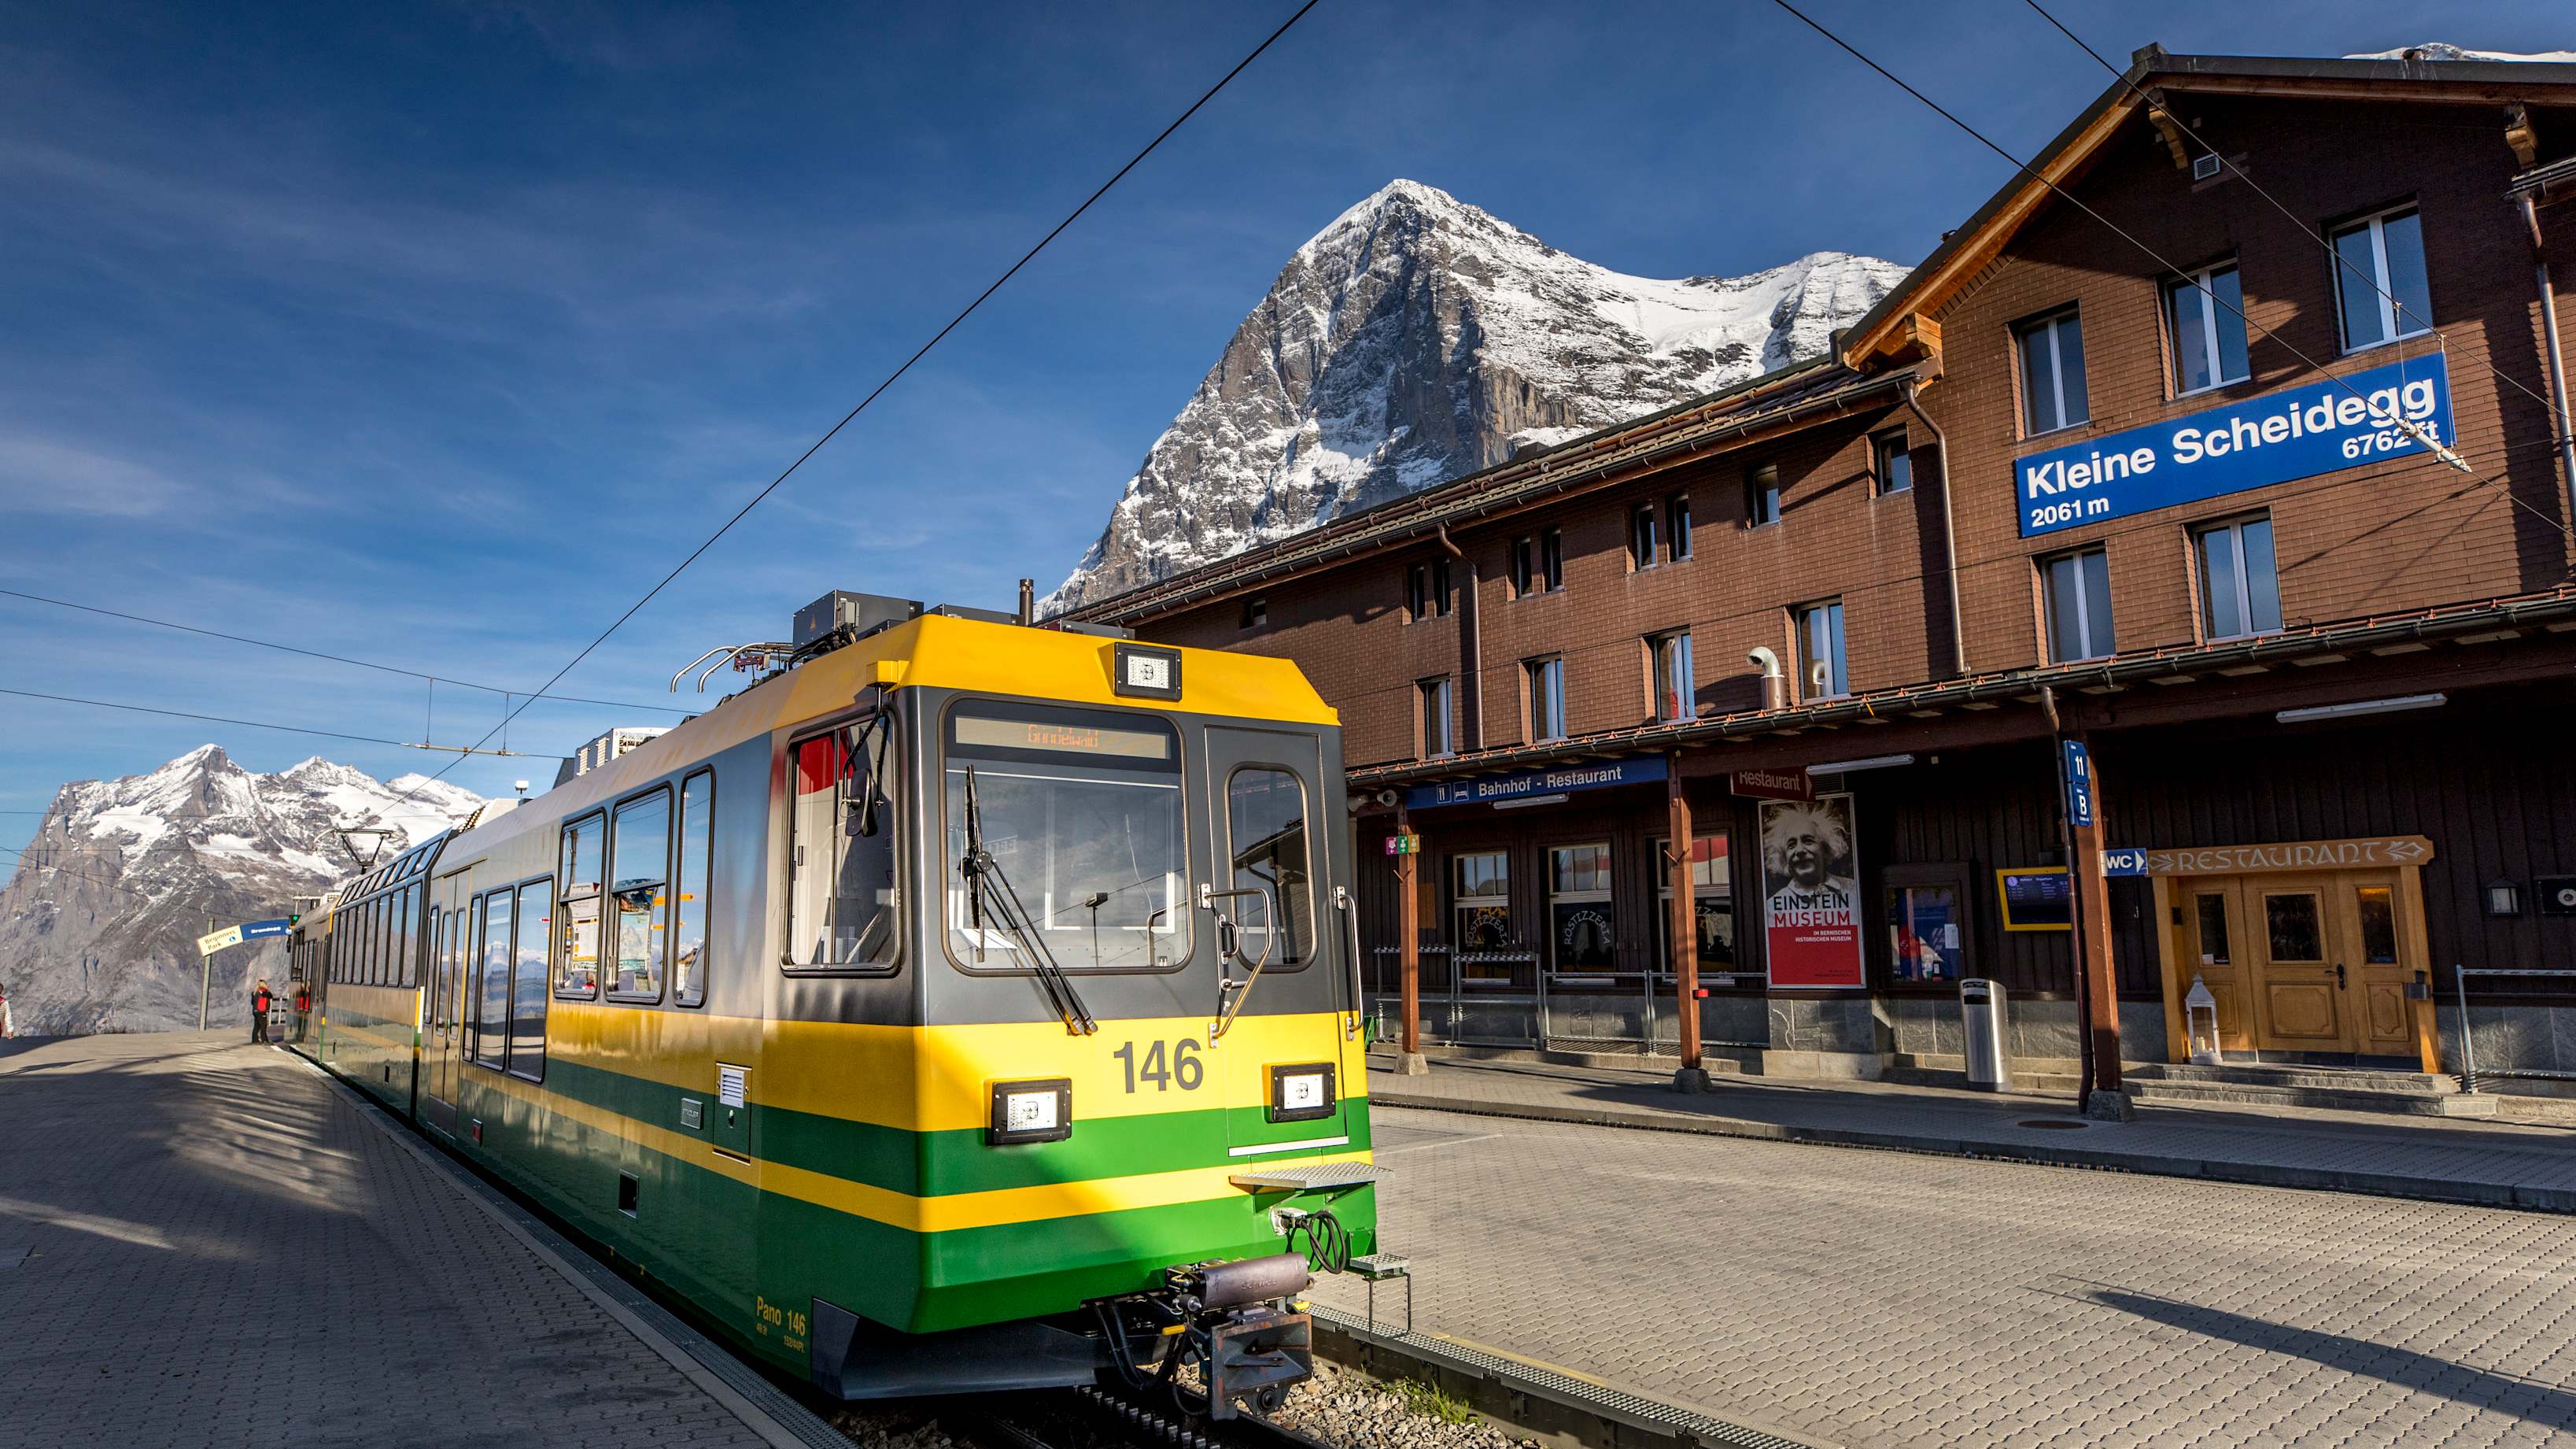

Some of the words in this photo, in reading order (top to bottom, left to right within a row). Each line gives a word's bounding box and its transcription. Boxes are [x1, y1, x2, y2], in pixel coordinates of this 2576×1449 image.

[2026, 446, 2157, 500] Kleine
[2172, 378, 2436, 464] Scheidegg
[2342, 427, 2412, 459] 6762
[2031, 501, 2083, 528] 2061
[2087, 497, 2110, 516] m
[1028, 723, 1098, 749] Grindelwald
[2075, 755, 2084, 777] 11
[1478, 777, 1532, 797] Bahnhof
[1546, 766, 1622, 789] Restaurant
[1739, 770, 1801, 792] Restaurant
[2078, 794, 2087, 816] B
[2106, 855, 2133, 870] WC
[2177, 841, 2382, 871] RESTAURANT
[1773, 893, 1850, 911] EINSTEIN
[1773, 910, 1851, 927] MUSEUM
[1113, 1038, 1204, 1094] 146
[756, 1295, 782, 1327] Pano
[787, 1309, 806, 1336] 146
